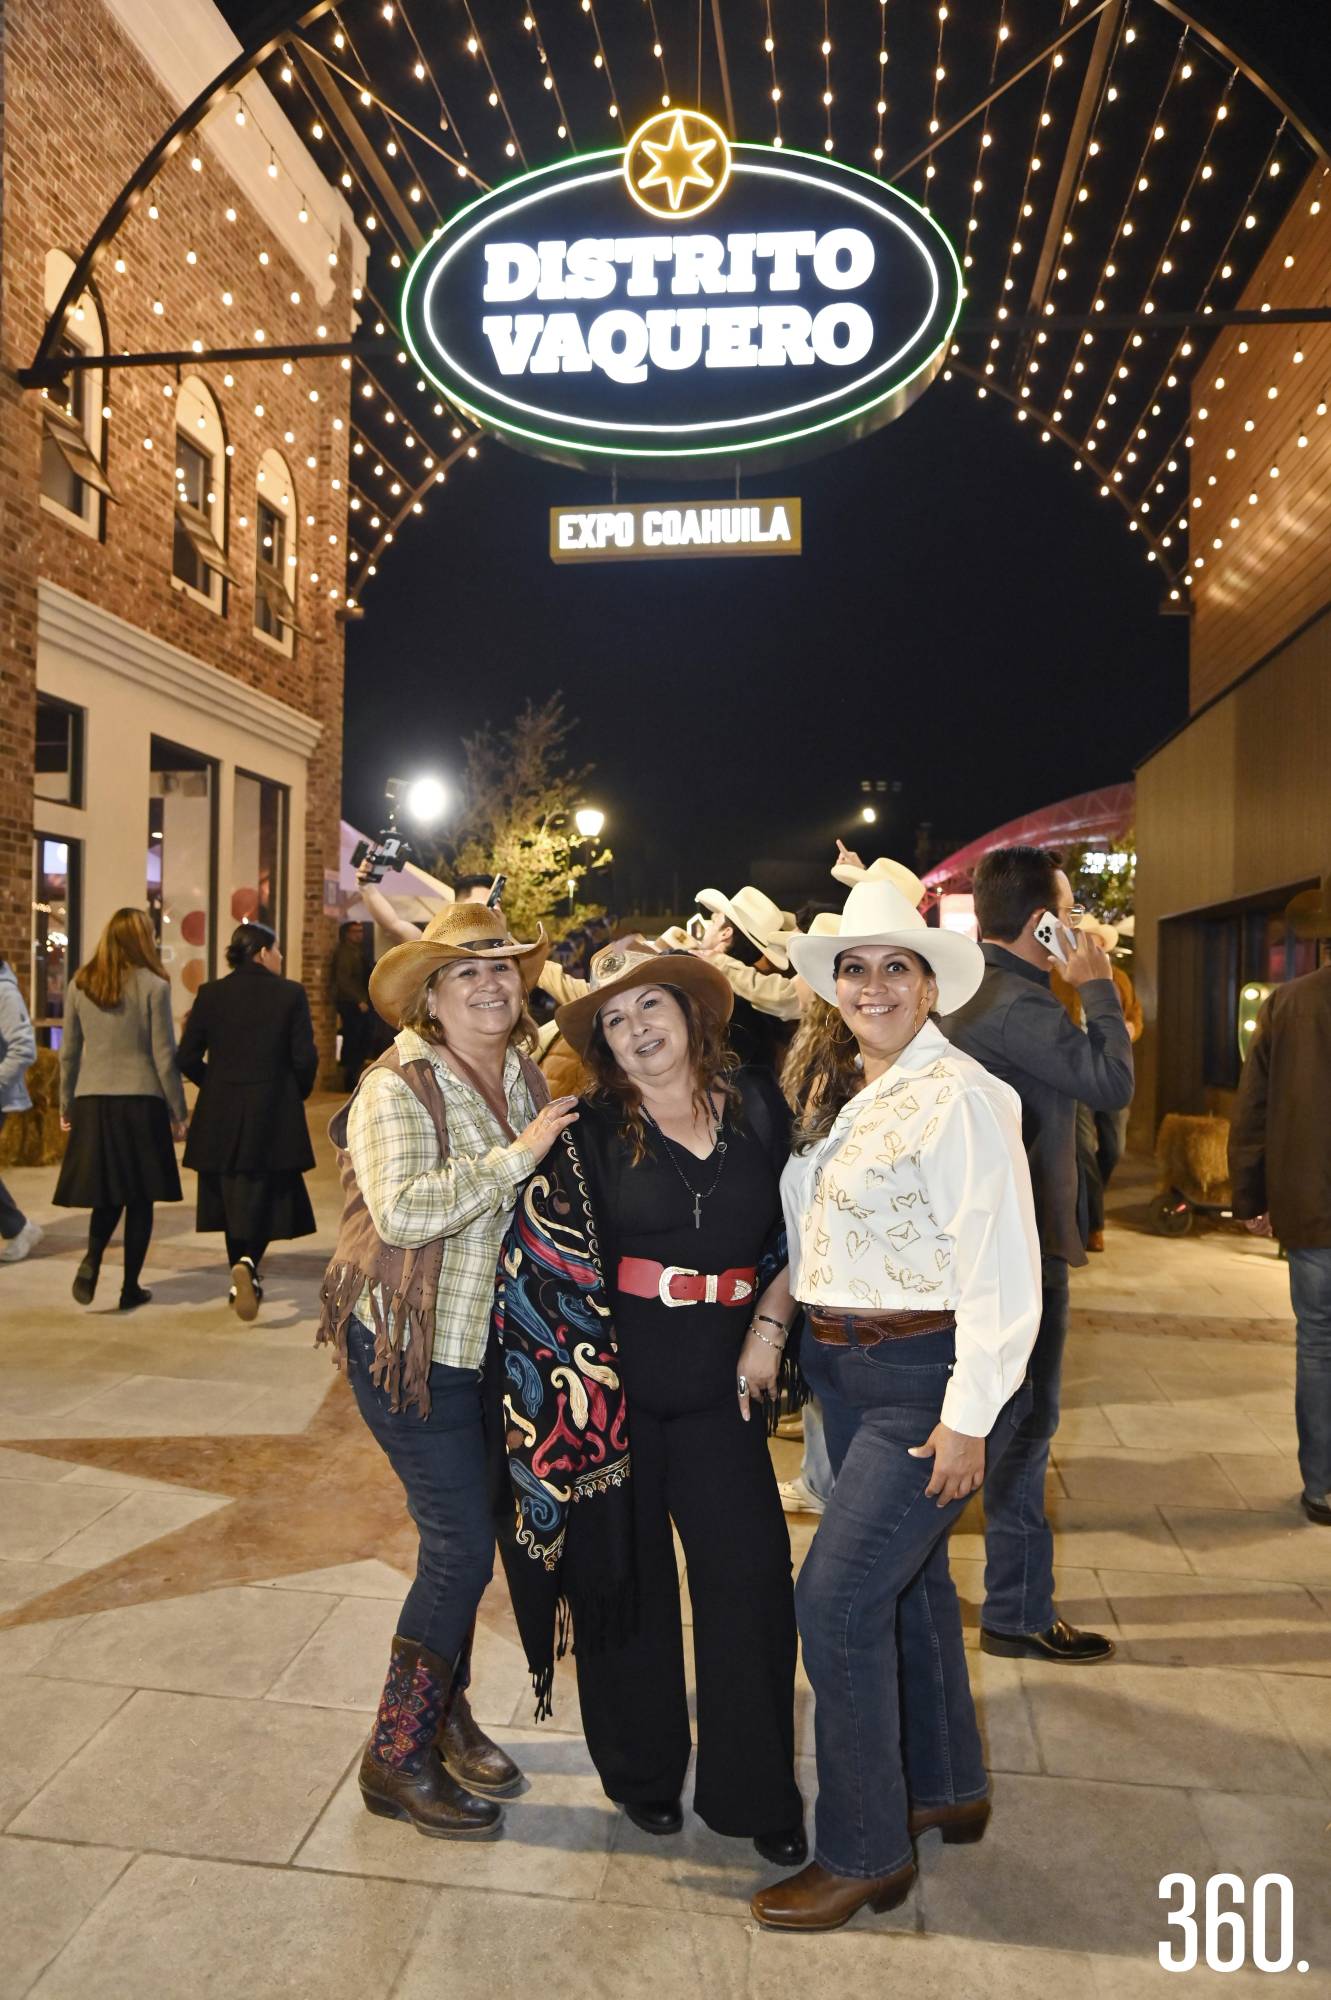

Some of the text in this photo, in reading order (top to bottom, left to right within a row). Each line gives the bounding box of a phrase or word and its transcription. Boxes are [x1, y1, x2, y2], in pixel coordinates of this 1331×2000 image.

[482, 228, 876, 302] DISTRITO
[482, 303, 875, 384] VAQUERO
[559, 505, 791, 549] EXPO COAHUILA
